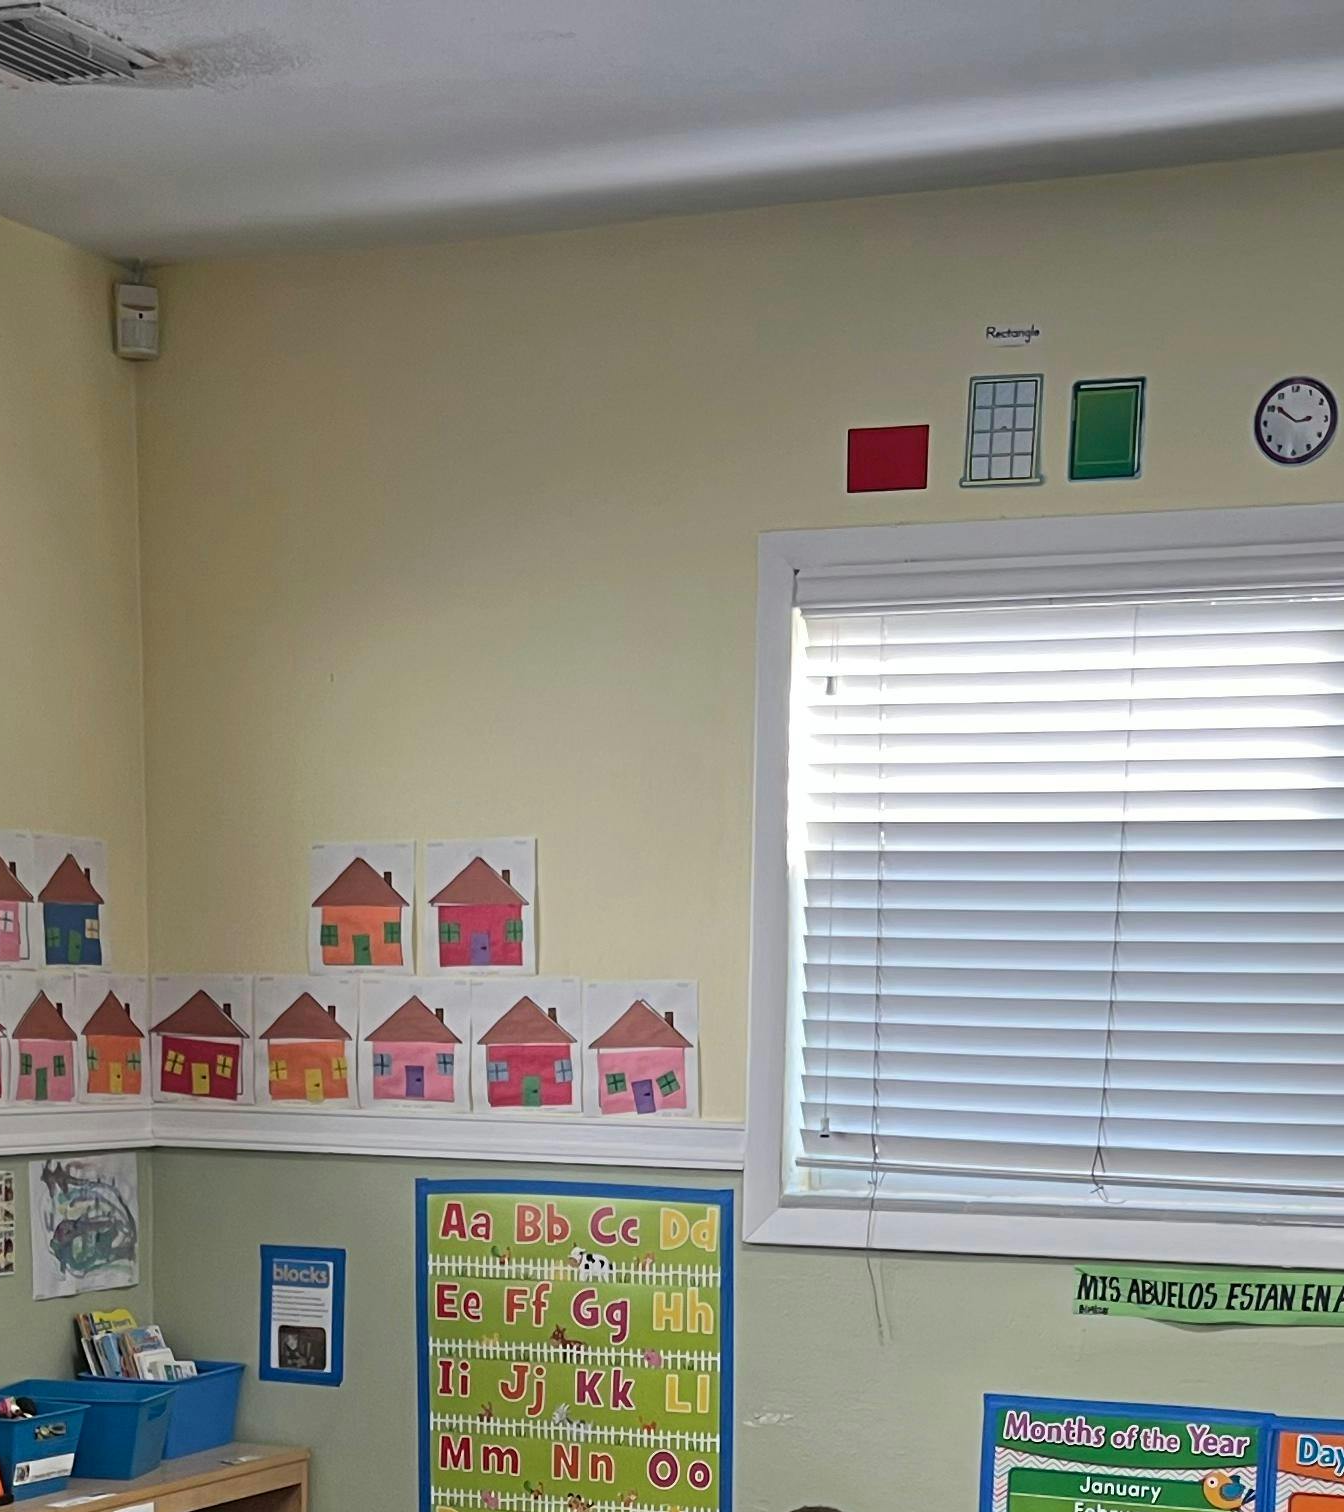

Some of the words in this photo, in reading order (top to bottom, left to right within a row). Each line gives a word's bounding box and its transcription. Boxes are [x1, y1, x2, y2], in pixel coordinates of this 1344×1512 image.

[985, 325, 1041, 343] Rectangle
[439, 1202, 492, 1240] Aa
[515, 1203, 571, 1244] Bb
[589, 1206, 639, 1246] Cc
[660, 1207, 719, 1251] Dd
[274, 1263, 328, 1284] blocks
[1078, 1273, 1120, 1302] MIS
[1128, 1279, 1218, 1309] ABUELOS
[1226, 1283, 1295, 1311] ESTAN
[1303, 1284, 1331, 1312] EN
[436, 1283, 482, 1321] Ee
[504, 1282, 551, 1327] Ff
[572, 1289, 630, 1344] Gg
[653, 1287, 714, 1334] Hh
[438, 1360, 471, 1396] Ii
[499, 1363, 546, 1416] Jj
[575, 1368, 635, 1410] Kk
[665, 1374, 710, 1413] Ll
[1004, 1410, 1105, 1448] Months
[1111, 1425, 1140, 1449] of
[1141, 1428, 1180, 1452] the
[1186, 1424, 1251, 1458] Year
[439, 1436, 520, 1476] Mm
[552, 1444, 614, 1483] Nn
[647, 1449, 712, 1490] Oo
[1079, 1476, 1162, 1504] January
